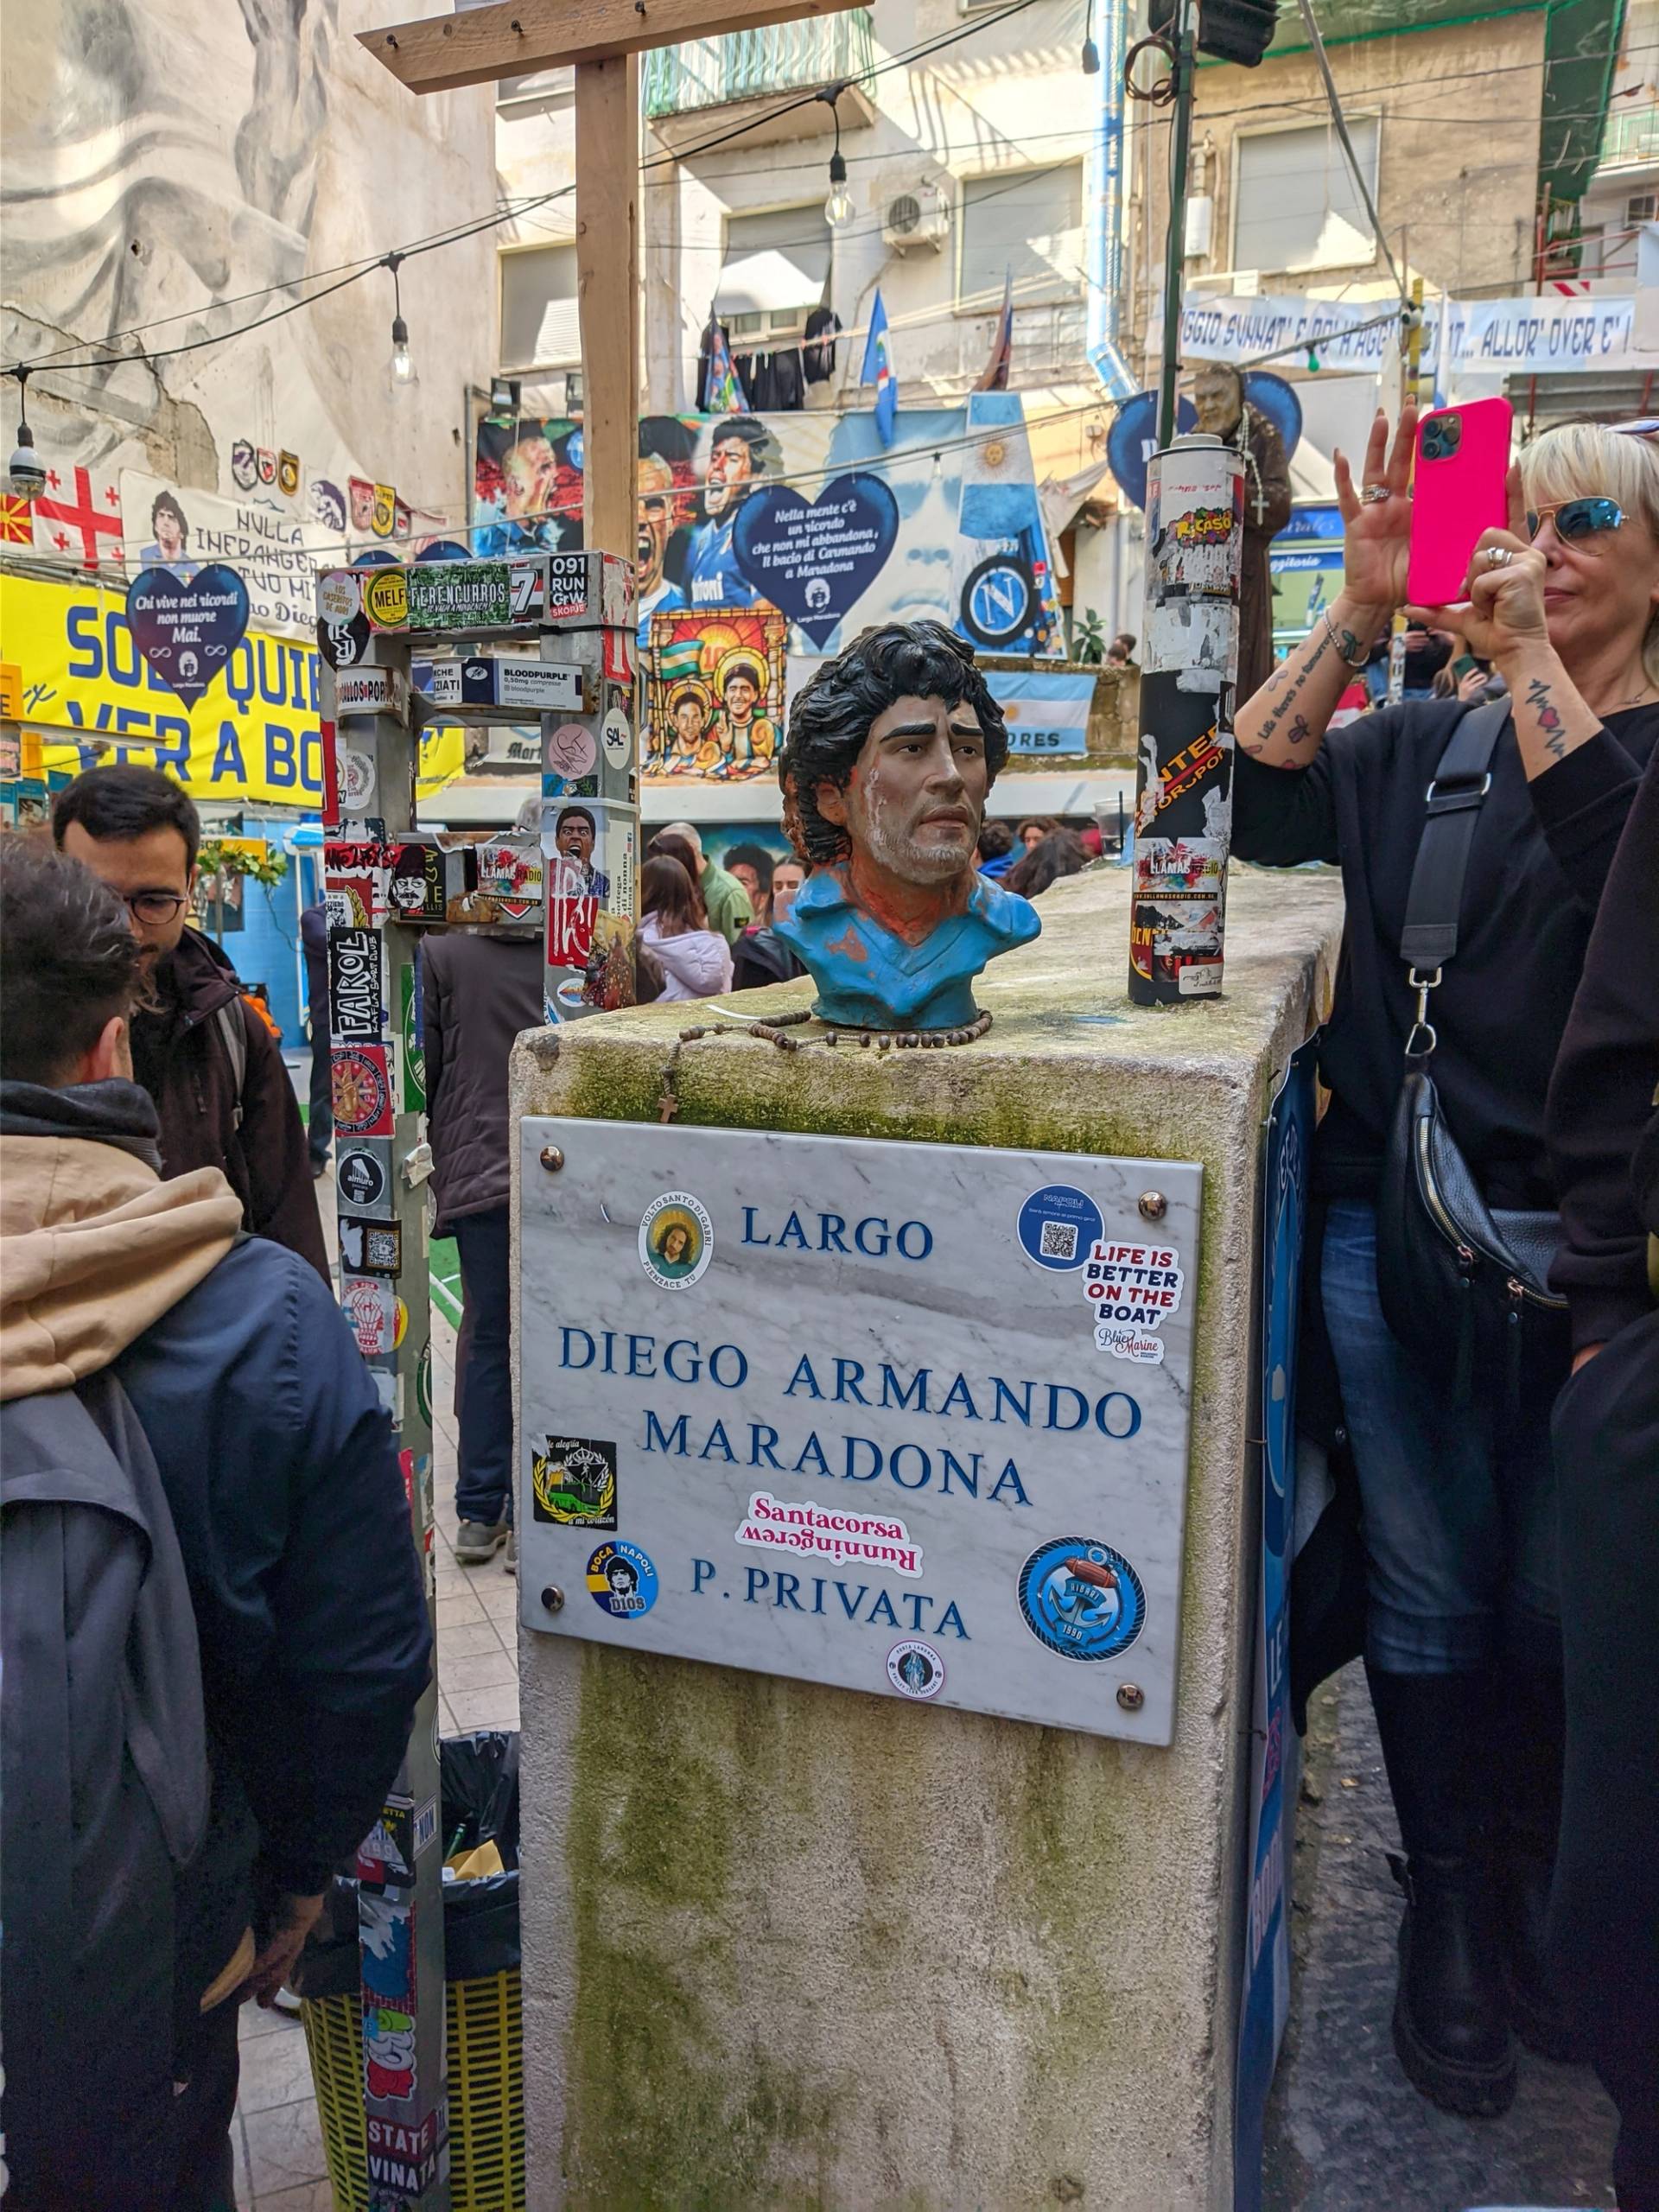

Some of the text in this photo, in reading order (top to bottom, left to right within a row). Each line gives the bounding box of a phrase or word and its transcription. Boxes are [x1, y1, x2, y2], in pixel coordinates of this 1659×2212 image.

[1548, 316, 1597, 356] OVER
[774, 508, 804, 523] Nella
[805, 504, 840, 518] mente
[237, 508, 305, 547] NULLA
[787, 518, 845, 536] un ricordo
[752, 543, 771, 555] che
[772, 540, 793, 552] non
[795, 536, 810, 549] mi
[772, 551, 802, 566] bacio
[803, 549, 816, 563] di
[818, 542, 876, 560] Carmando
[552, 557, 585, 575] 091
[785, 561, 855, 579] a Maradona
[552, 576, 585, 592] RUN
[136, 591, 238, 610] Chi vive nei ricordi
[552, 604, 585, 617] SKOPJE
[157, 611, 217, 625] non muore
[275, 601, 318, 633] Dieg
[172, 626, 202, 644] Mai.
[504, 669, 569, 681] BLOODPURPLE
[210, 721, 248, 784] A
[662, 1194, 695, 1207] SANTO
[741, 1205, 934, 1262] LARGO
[1094, 1245, 1173, 1268] LIFE IS
[1086, 1263, 1179, 1288] BETTER
[1087, 1283, 1175, 1307] ON THE
[1098, 1303, 1161, 1325] BOAT
[557, 1325, 1142, 1440] DIEGO ARMANDO
[641, 1408, 1034, 1508] MARADONA
[754, 1497, 905, 1541] Santacorsa
[741, 1526, 918, 1572] Runningcrew
[590, 1544, 655, 1578] BOCA NAPOLI
[1062, 1624, 1083, 1640] 1990
[367, 2120, 429, 2155] STATE
